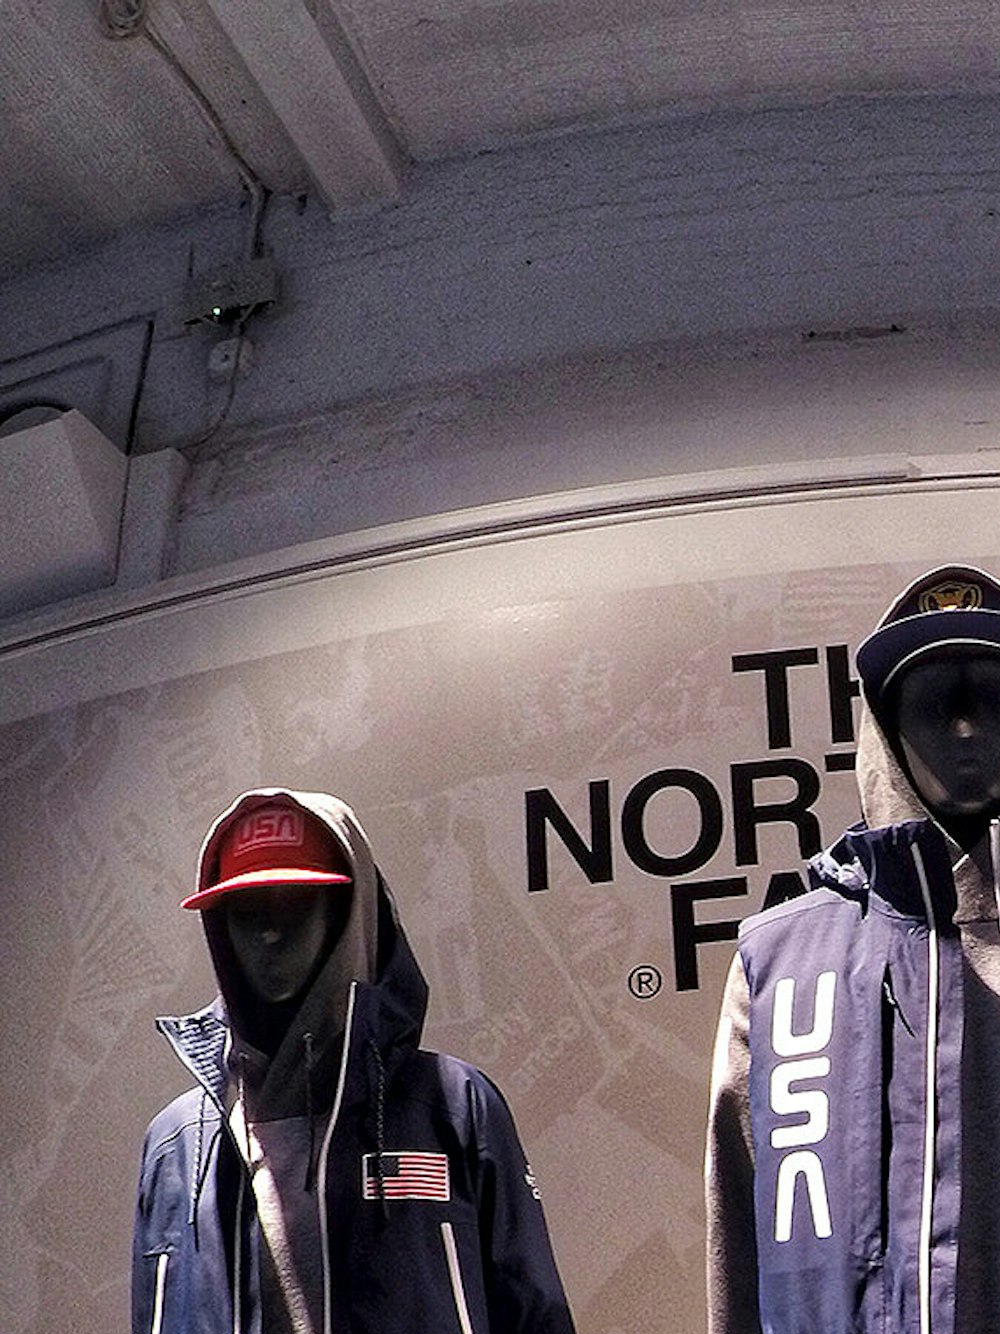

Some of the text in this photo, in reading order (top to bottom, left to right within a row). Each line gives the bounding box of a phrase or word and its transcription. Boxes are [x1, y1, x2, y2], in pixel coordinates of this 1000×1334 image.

[238, 812, 298, 850] USA
[524, 752, 857, 893] NOR
[770, 970, 837, 1243] USA
